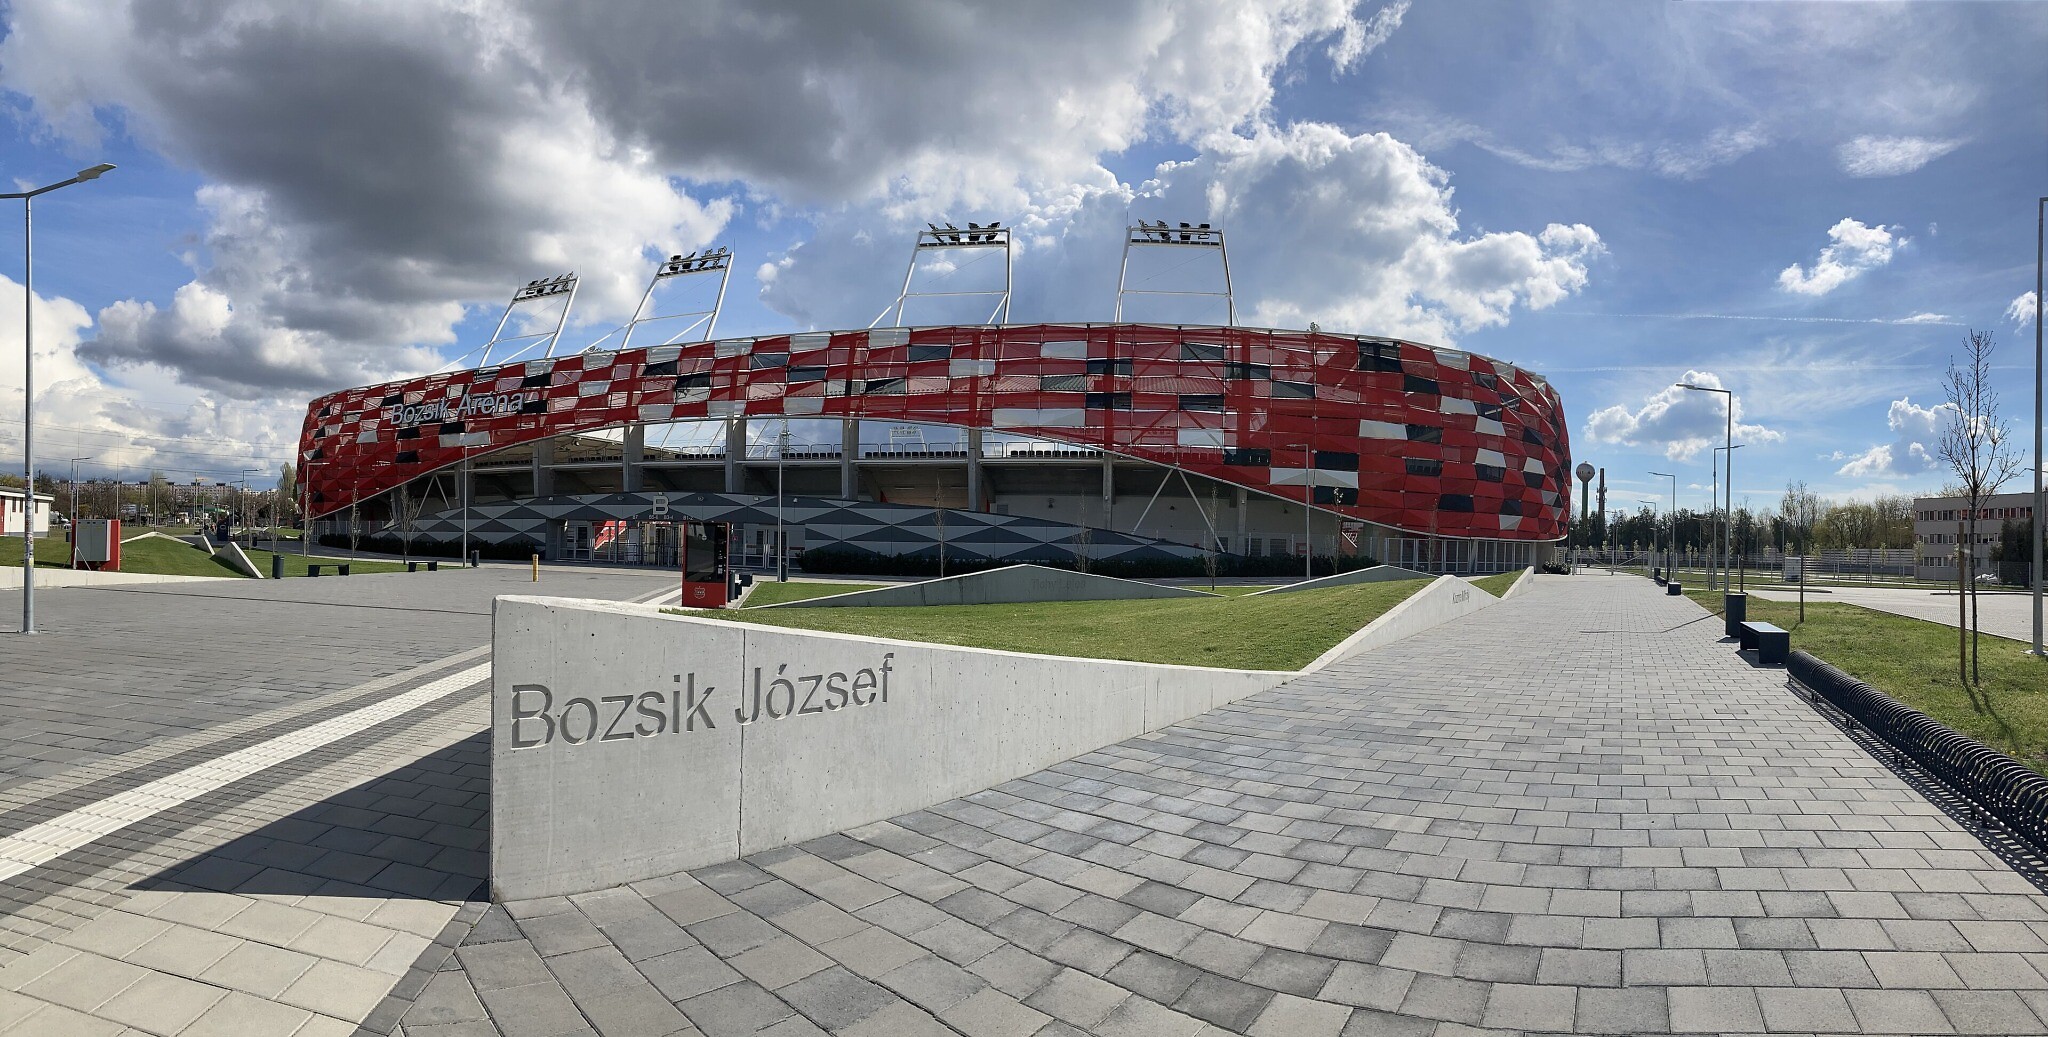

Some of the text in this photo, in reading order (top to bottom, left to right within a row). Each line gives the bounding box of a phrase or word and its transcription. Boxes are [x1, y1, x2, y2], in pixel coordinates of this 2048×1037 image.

[391, 391, 524, 425] Bozsik Aréna
[653, 496, 669, 514] B
[511, 653, 895, 750] Bozsik József
